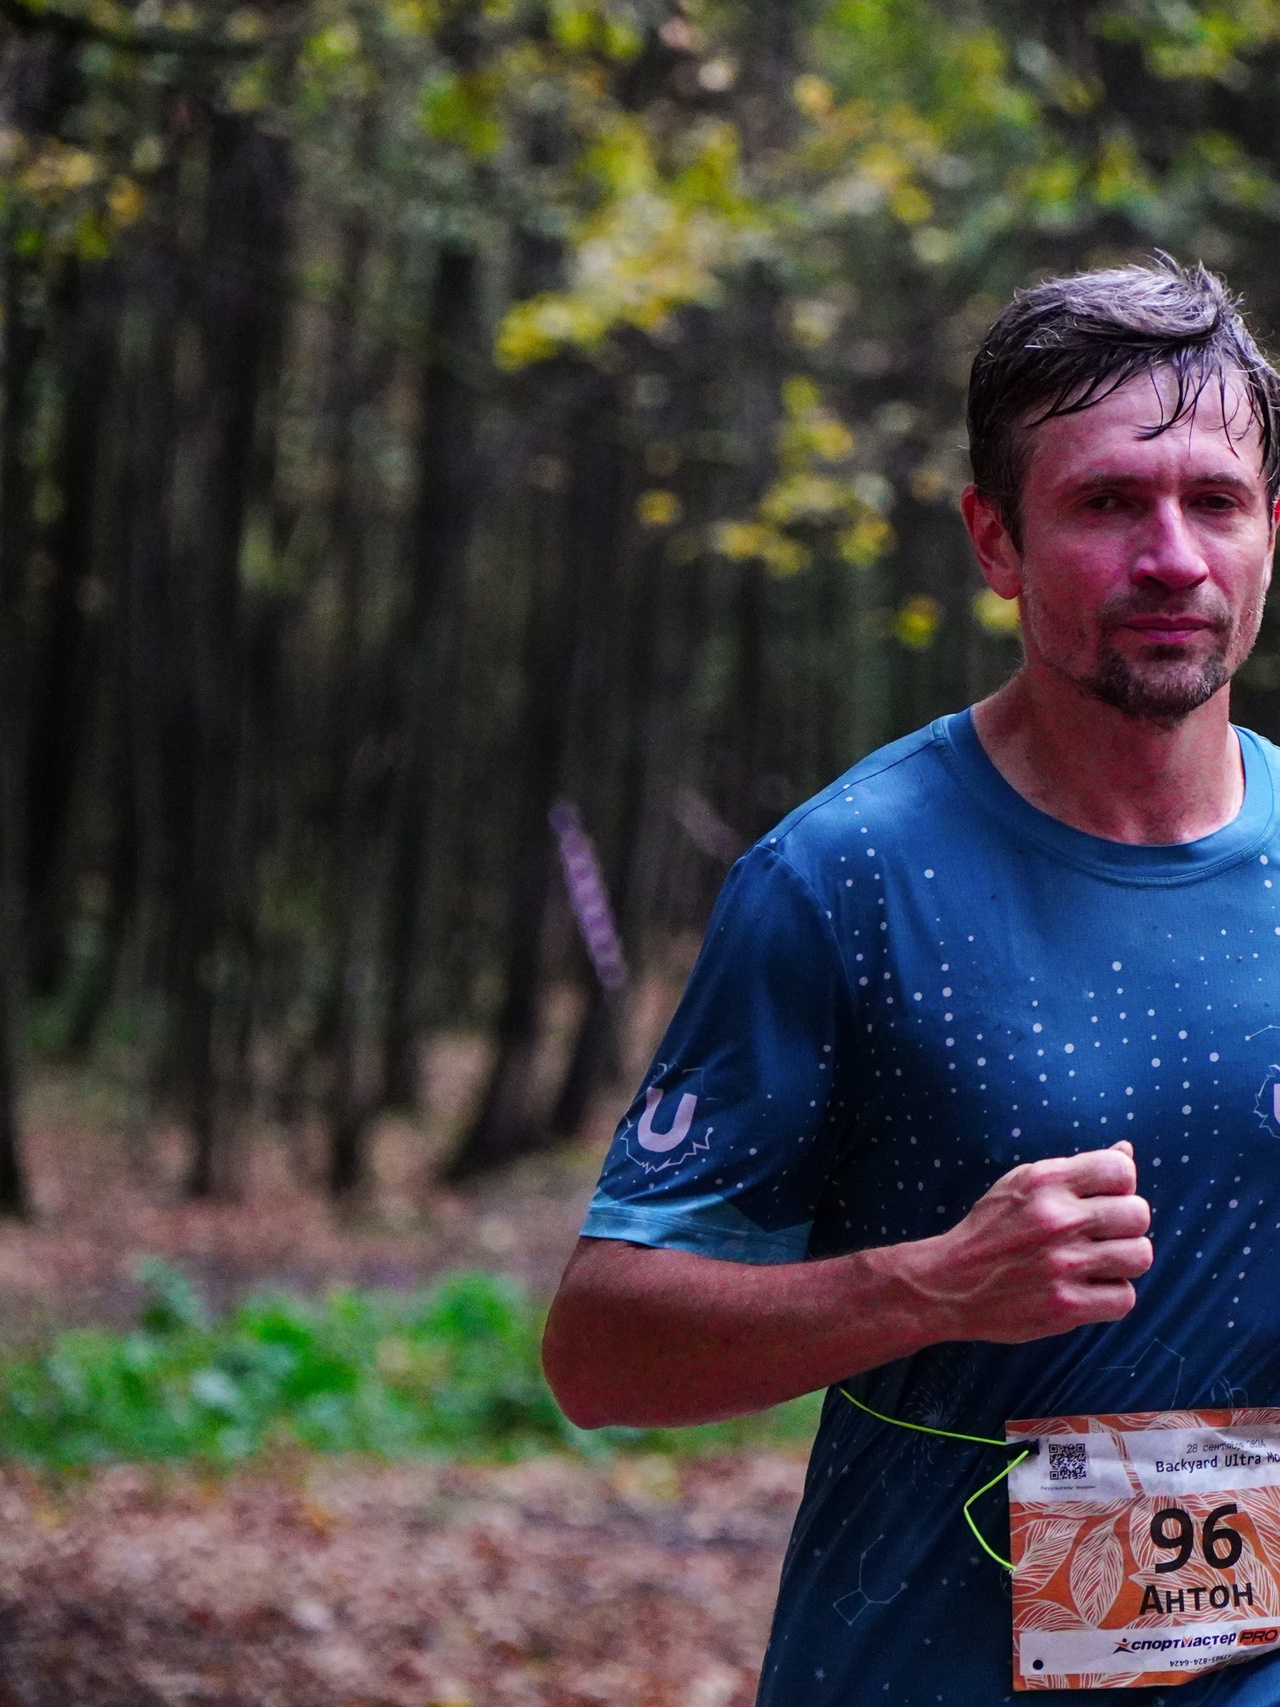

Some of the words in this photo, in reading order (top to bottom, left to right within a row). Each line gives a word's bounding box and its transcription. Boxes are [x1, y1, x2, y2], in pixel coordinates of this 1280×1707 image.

[638, 1087, 697, 1153] U
[1186, 1443, 1198, 1454] 28
[1155, 1455, 1218, 1473] Backyard
[1224, 1453, 1261, 1467] Ultra
[1149, 1503, 1243, 1575] 96
[1239, 1629, 1278, 1643] PRO
